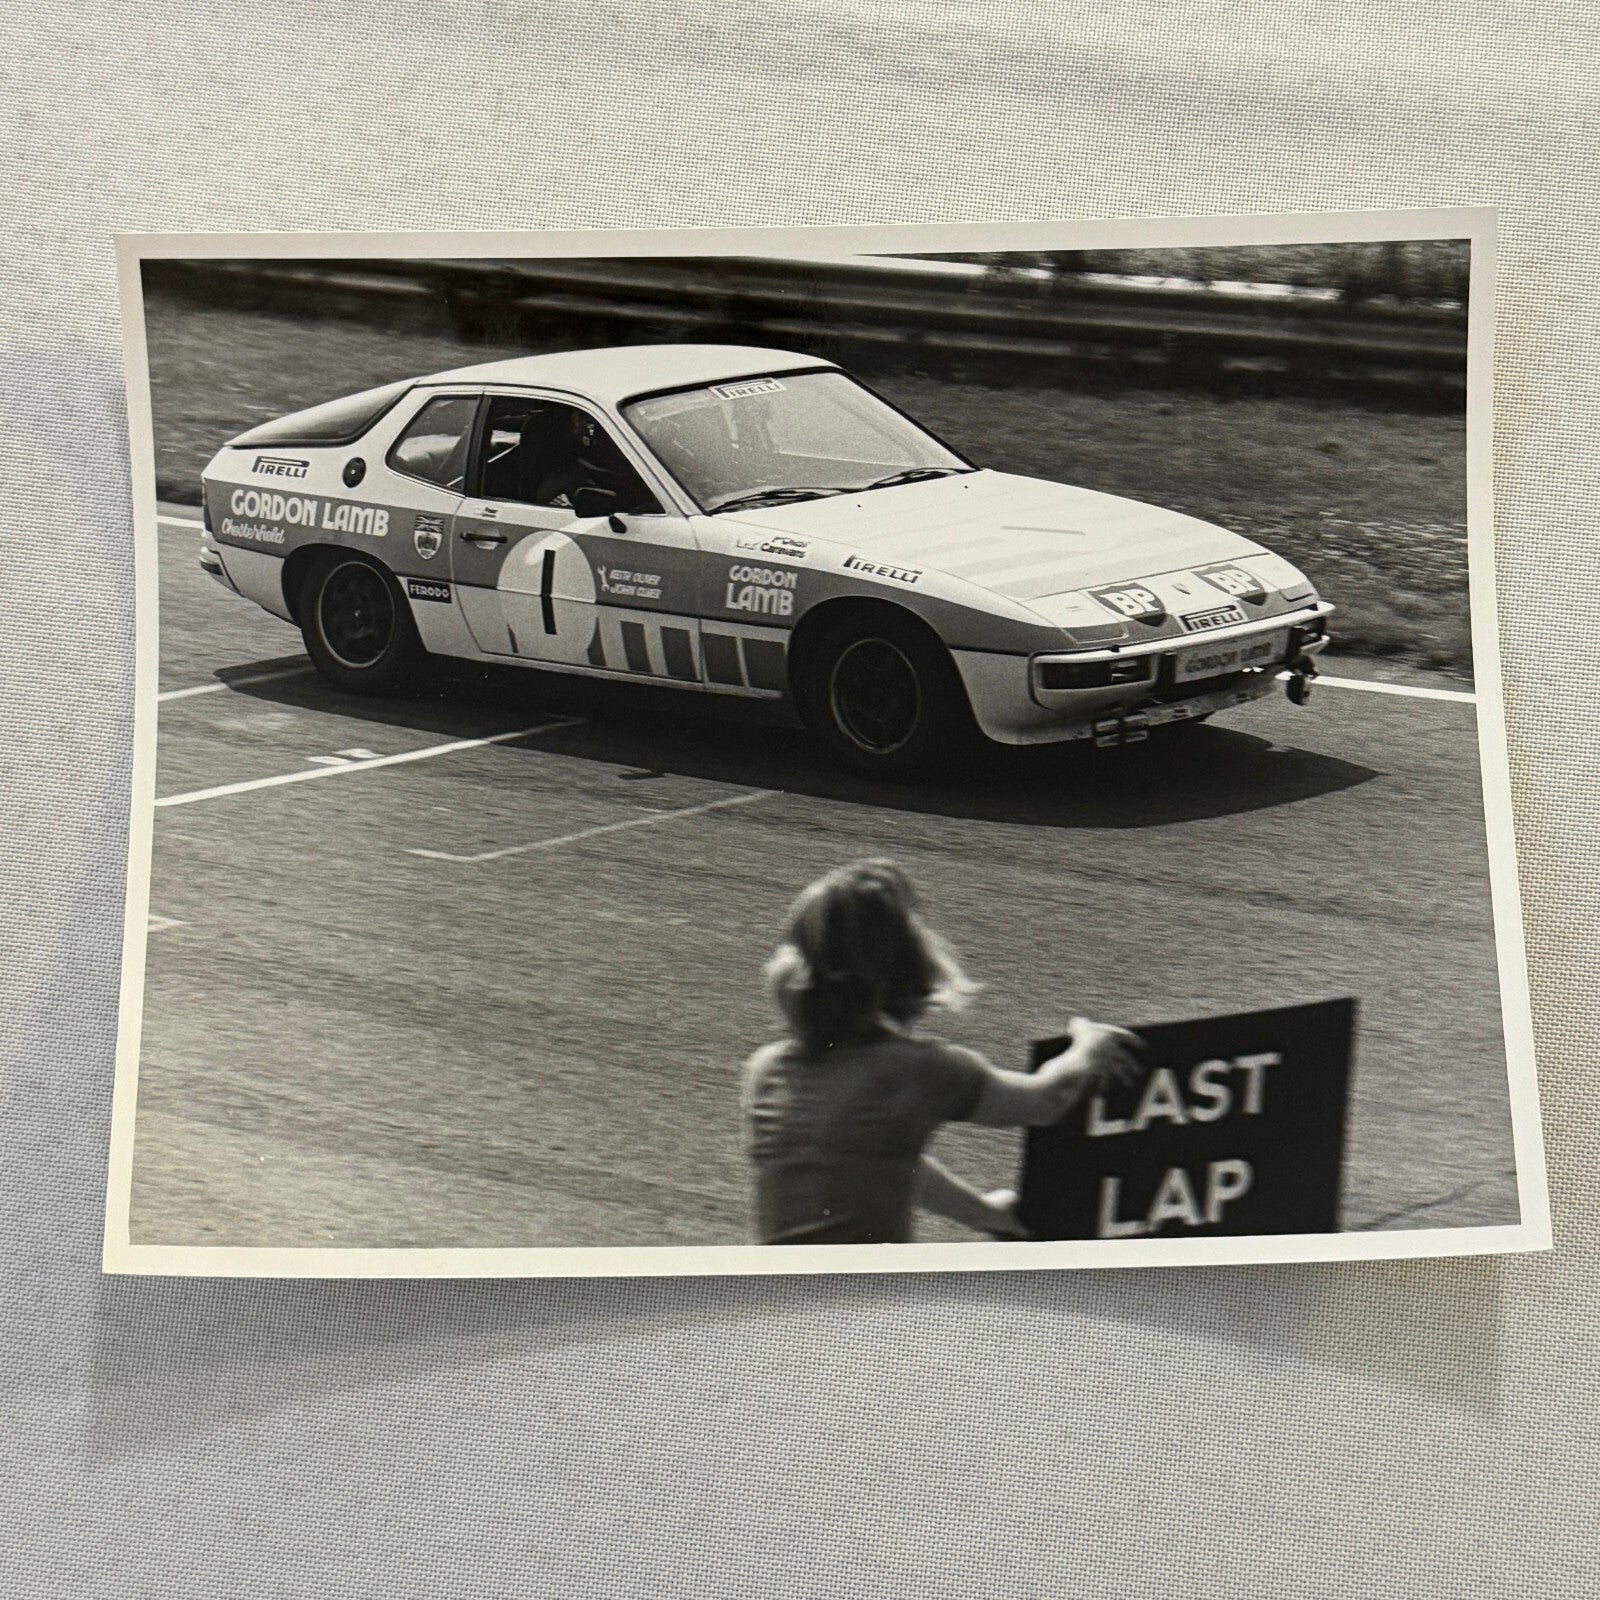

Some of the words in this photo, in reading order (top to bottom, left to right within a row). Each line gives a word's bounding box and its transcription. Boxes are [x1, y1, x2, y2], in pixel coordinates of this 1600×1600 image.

[714, 379, 780, 399] PIRELLI
[252, 456, 310, 479] PIRELLI
[231, 488, 318, 527] GORDON
[321, 502, 390, 537] LAMB
[729, 564, 799, 589] GORDON
[843, 554, 923, 584] PIRELLI
[1203, 569, 1261, 596] BP
[409, 583, 450, 599] FERODO
[539, 549, 557, 636] 1
[725, 582, 794, 616] LAMB
[1101, 588, 1160, 617] BP
[1178, 604, 1243, 632] PIRELLI
[1085, 1052, 1282, 1137] LAST
[1098, 1158, 1254, 1239] LAP
